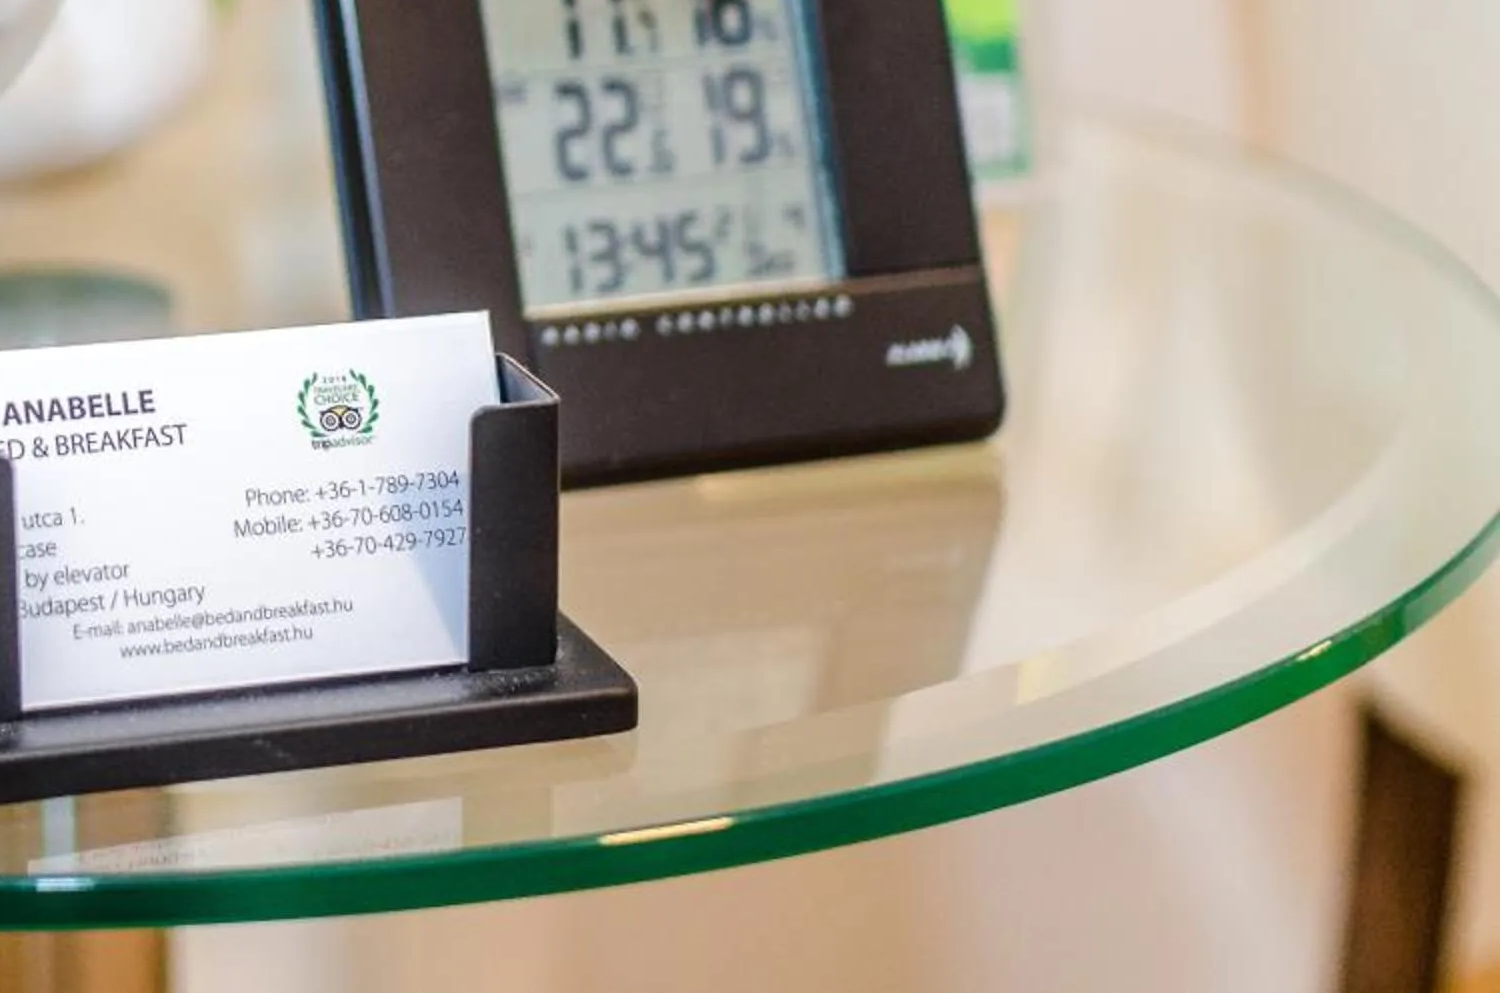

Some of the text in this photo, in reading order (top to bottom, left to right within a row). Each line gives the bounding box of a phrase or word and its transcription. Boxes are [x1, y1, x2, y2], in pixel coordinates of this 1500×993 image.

[702, 67, 773, 166] 19
[2, 389, 156, 426] ANABELLE
[32, 435, 50, 459] &
[55, 423, 188, 457] BREAKFAST
[244, 470, 460, 508] Phone: +36-1-789-7304
[21, 506, 85, 530] utca 1.
[233, 499, 464, 538] Mobile: +36-70-608-0154
[311, 526, 467, 559] +36-70-429-7927
[24, 563, 130, 592] by elevator
[18, 584, 206, 620] Budapest / Hungary
[72, 597, 354, 641] E-mail: anabelle@bedandbreakfast.hu
[119, 624, 314, 659] www.bedandbreakfast.hu
